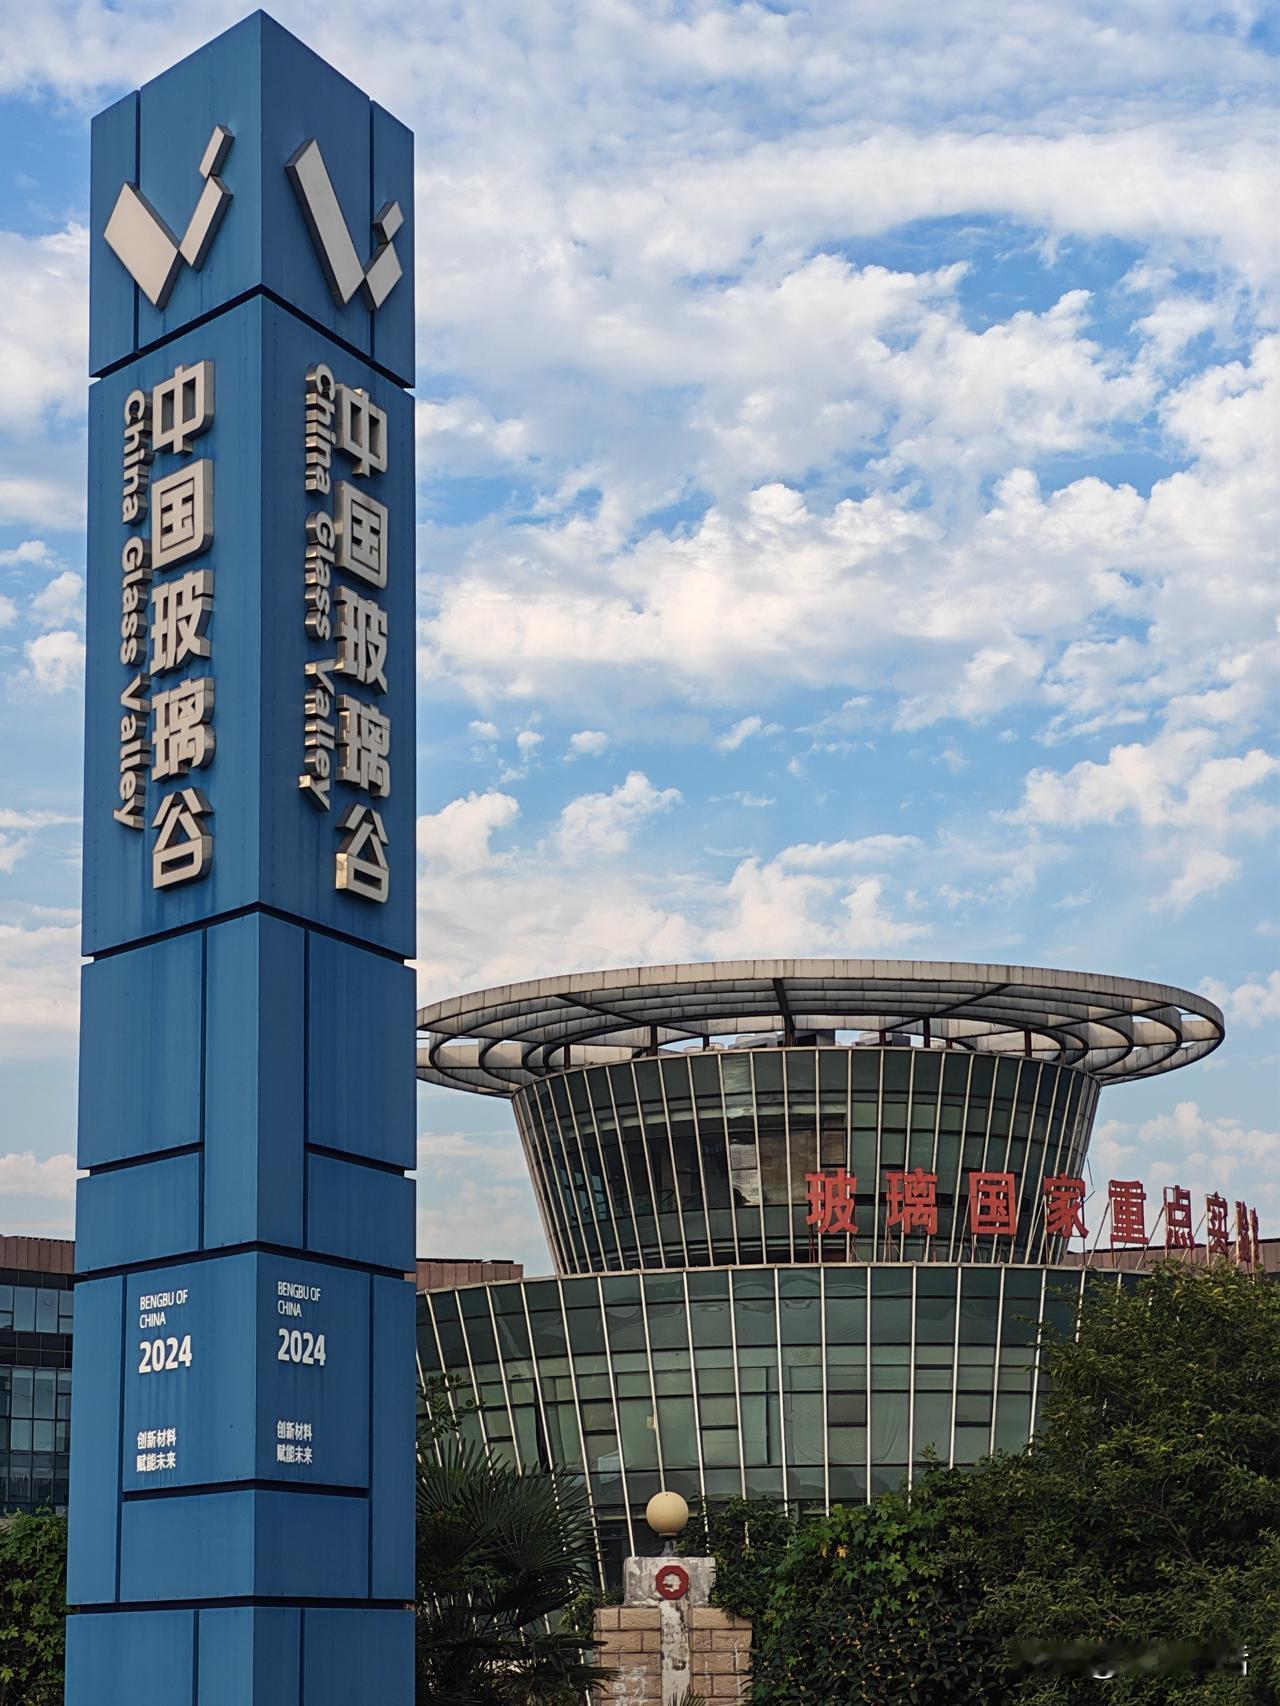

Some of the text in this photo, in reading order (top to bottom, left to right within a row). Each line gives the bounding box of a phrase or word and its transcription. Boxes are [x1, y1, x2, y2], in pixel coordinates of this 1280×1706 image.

[299, 363, 336, 811] China Glass Valley
[113, 389, 152, 830] China Glass Valley
[151, 360, 215, 891] 中国玻璃谷
[335, 384, 390, 903] 中国玻璃谷
[805, 1167, 1259, 1263] 玻璃国家重点实
[140, 1289, 188, 1311] BENGBU OF
[278, 1281, 321, 1302] BENGBU OF
[277, 1300, 302, 1318] CHINA
[139, 1313, 166, 1329] CHINA
[139, 1335, 192, 1374] 2024
[277, 1328, 326, 1366] 2024
[137, 1428, 176, 1450] 创新材料
[277, 1420, 312, 1442] 创新材料
[136, 1450, 176, 1472] 赋能未来
[277, 1444, 312, 1464] 赋能未来
